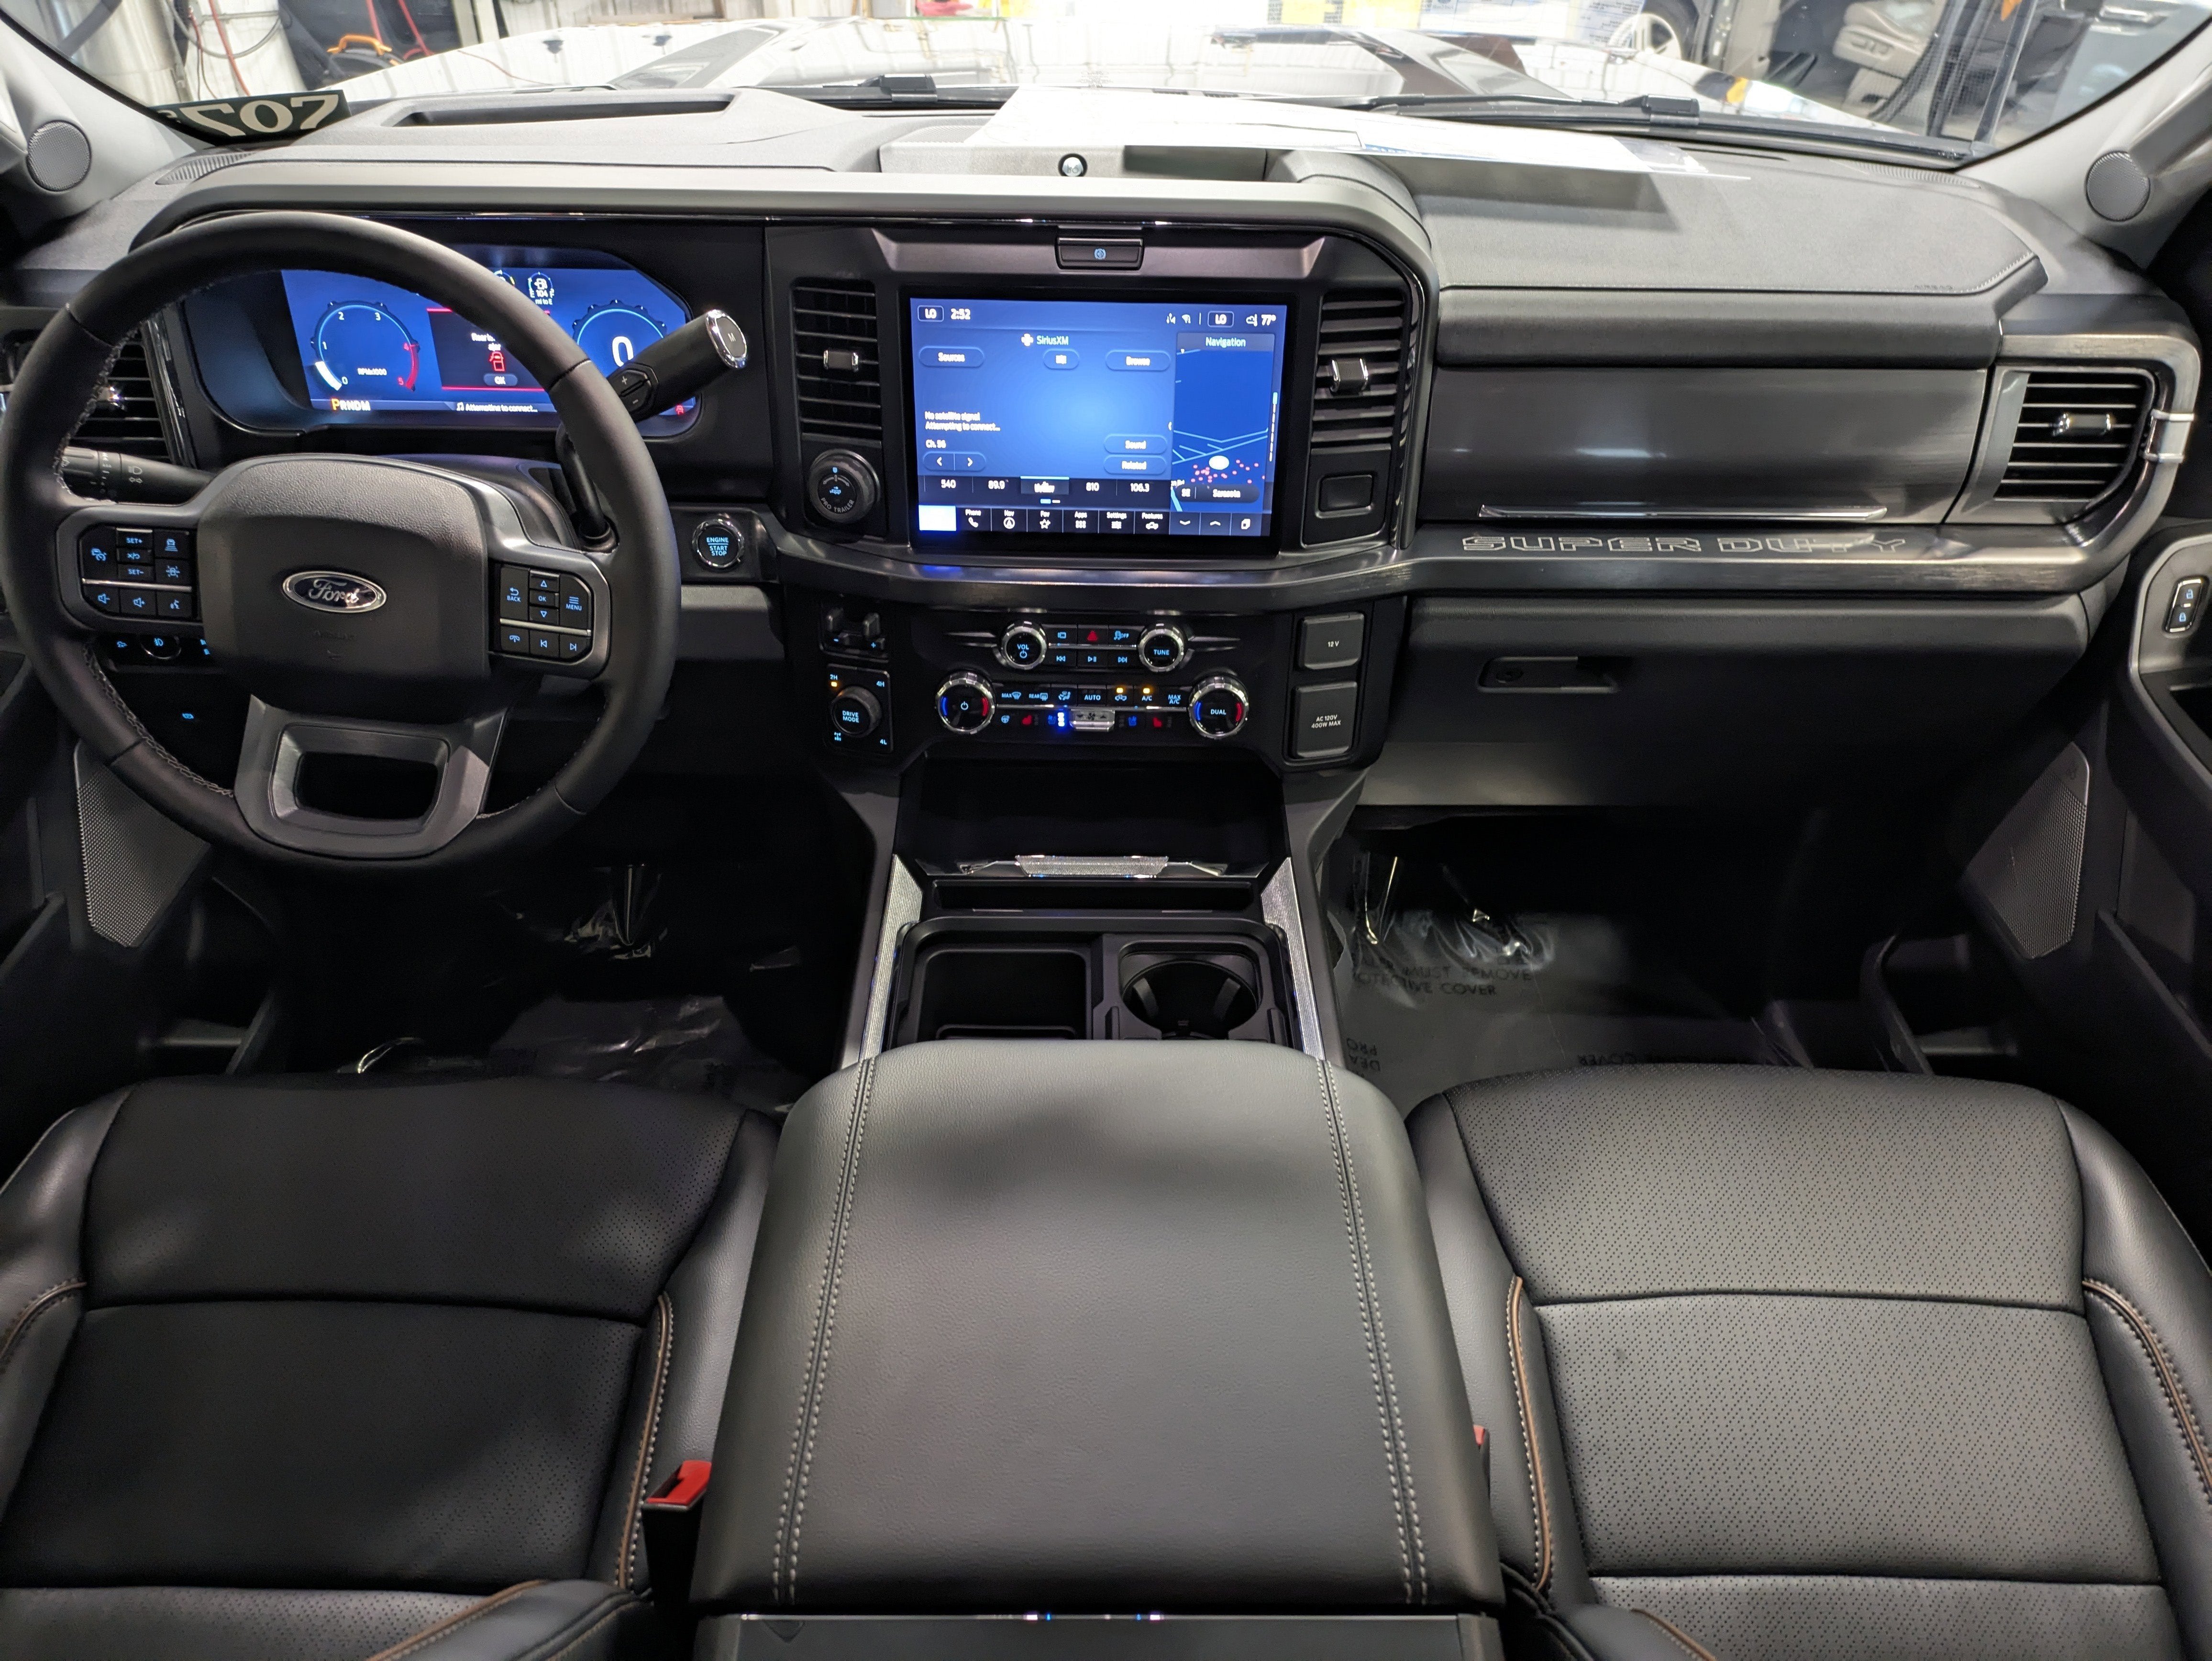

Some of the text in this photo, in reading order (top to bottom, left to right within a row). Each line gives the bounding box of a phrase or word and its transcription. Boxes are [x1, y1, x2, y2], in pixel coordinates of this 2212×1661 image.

[338, 311, 344, 321] 2
[375, 312, 381, 321] 3
[925, 308, 971, 320] LO 2:52
[727, 332, 736, 342] M
[1036, 335, 1069, 345] SiriusXM
[322, 341, 327, 350] 1
[1205, 336, 1246, 348] Navigation
[611, 336, 634, 367] 0
[342, 376, 348, 385] 0
[397, 377, 404, 386] 5
[494, 376, 506, 384] OK
[1125, 440, 1146, 449] Sound
[940, 479, 956, 488] 540
[988, 480, 1005, 489] 89.9
[1085, 482, 1100, 492] 810
[1130, 483, 1150, 493] 106.3
[820, 498, 854, 513] PRO TRAILER
[965, 509, 981, 517] Phone
[1106, 511, 1127, 520] Settings
[1141, 512, 1163, 520] Features
[1462, 536, 1702, 552] SUPER
[308, 578, 360, 604] Ford
[566, 603, 582, 611] MENU
[1439, 981, 1496, 996] COVER
